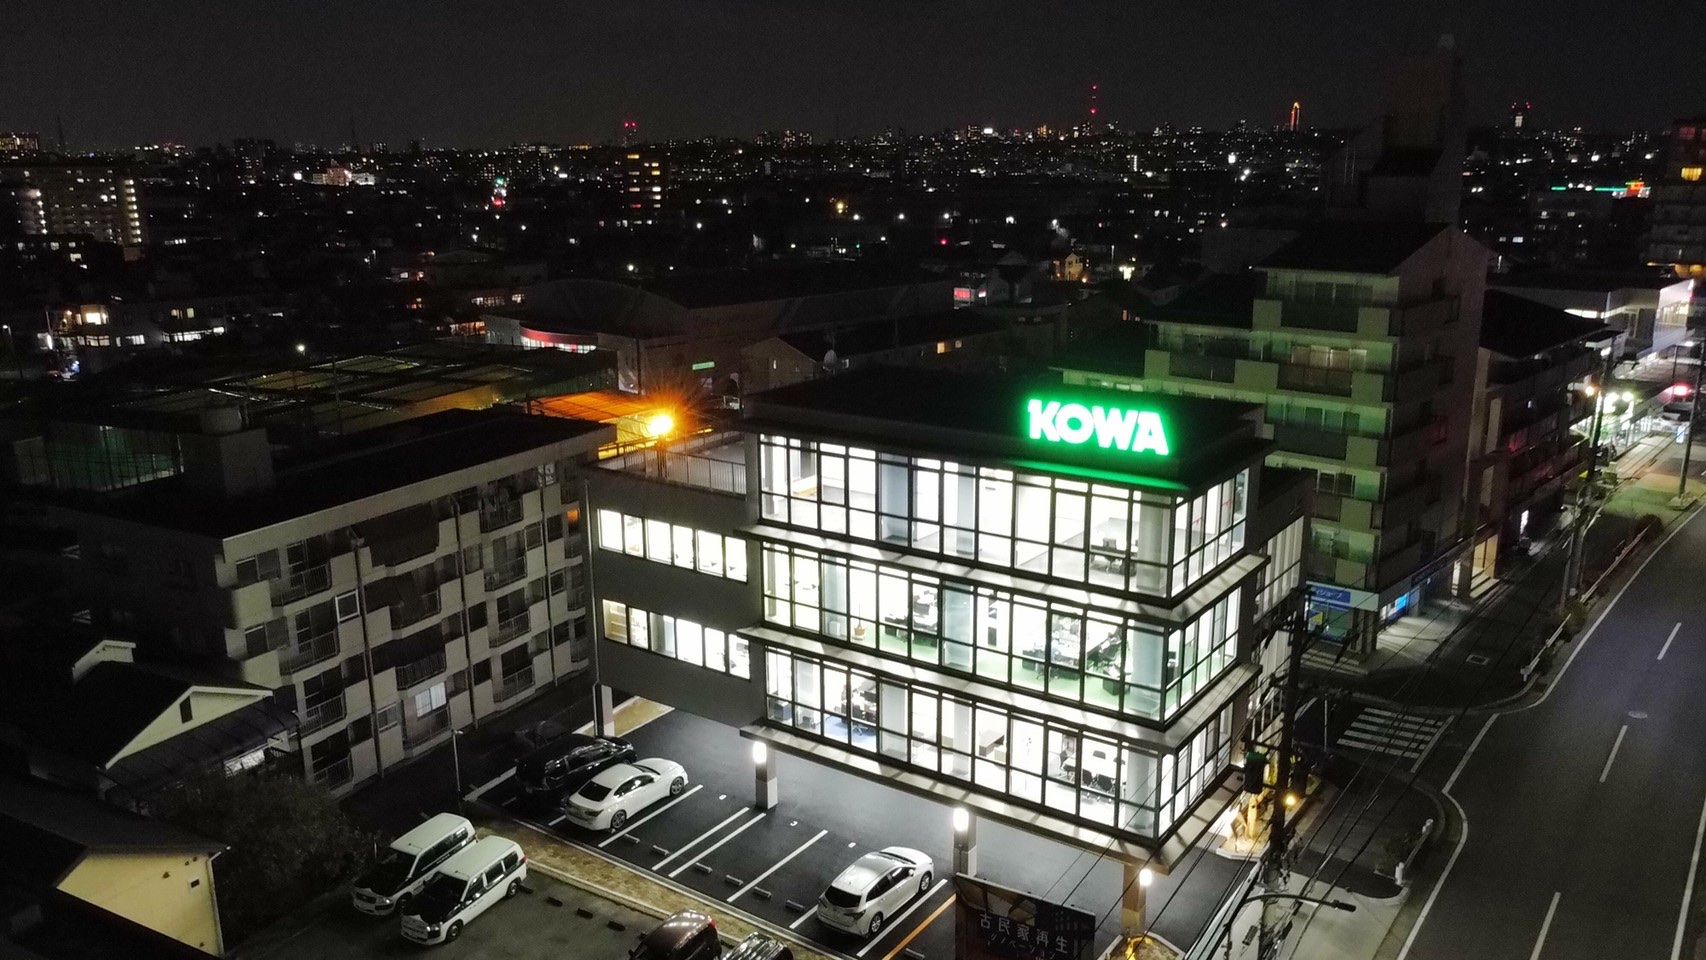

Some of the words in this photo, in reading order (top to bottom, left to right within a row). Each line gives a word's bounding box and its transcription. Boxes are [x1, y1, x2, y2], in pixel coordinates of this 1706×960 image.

[1028, 399, 1169, 456] KOWA
[979, 912, 1068, 954] 古民家再生
